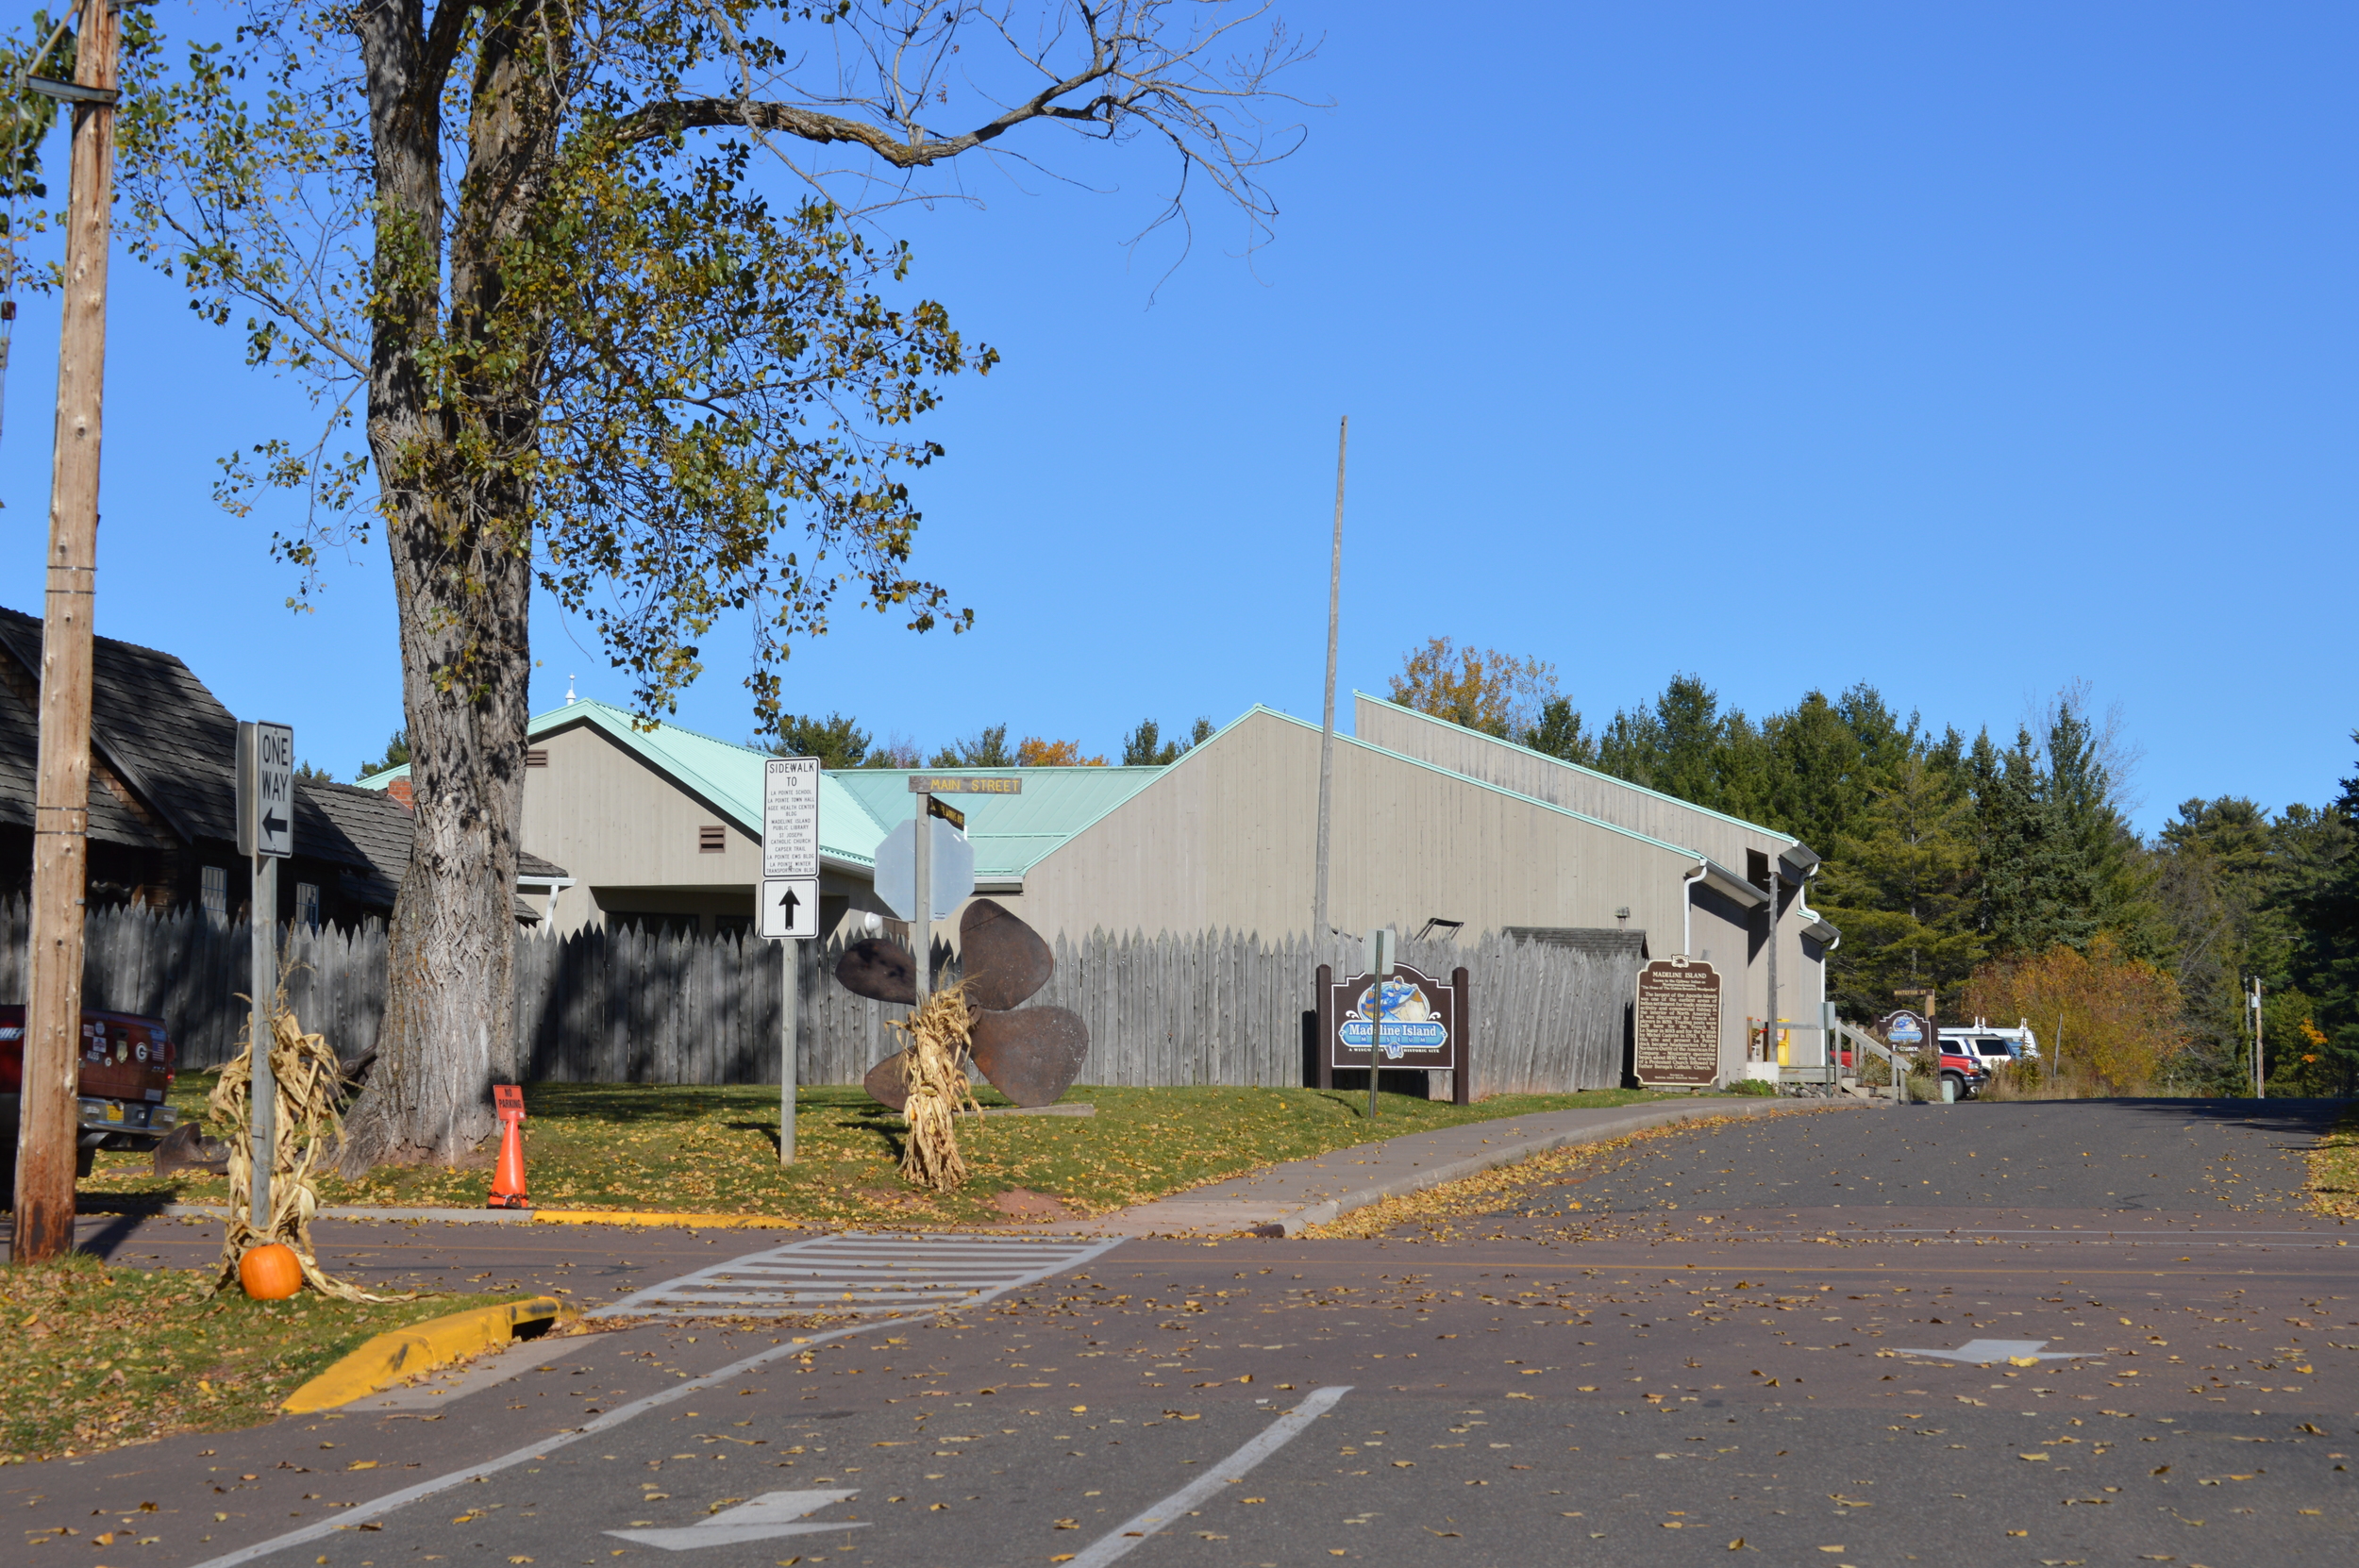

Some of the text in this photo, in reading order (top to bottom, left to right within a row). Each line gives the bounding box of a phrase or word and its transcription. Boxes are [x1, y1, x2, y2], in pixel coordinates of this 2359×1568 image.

[262, 734, 288, 767] ONE
[769, 762, 814, 773] SIDEWALK
[262, 770, 288, 801] WAY
[787, 777, 797, 786] TO
[930, 779, 1019, 791] MAIN STREET
[1349, 1024, 1437, 1036] Madline Island
[137, 1044, 147, 1060] G
[504, 1088, 512, 1097] NO
[499, 1099, 522, 1108] PARKING
